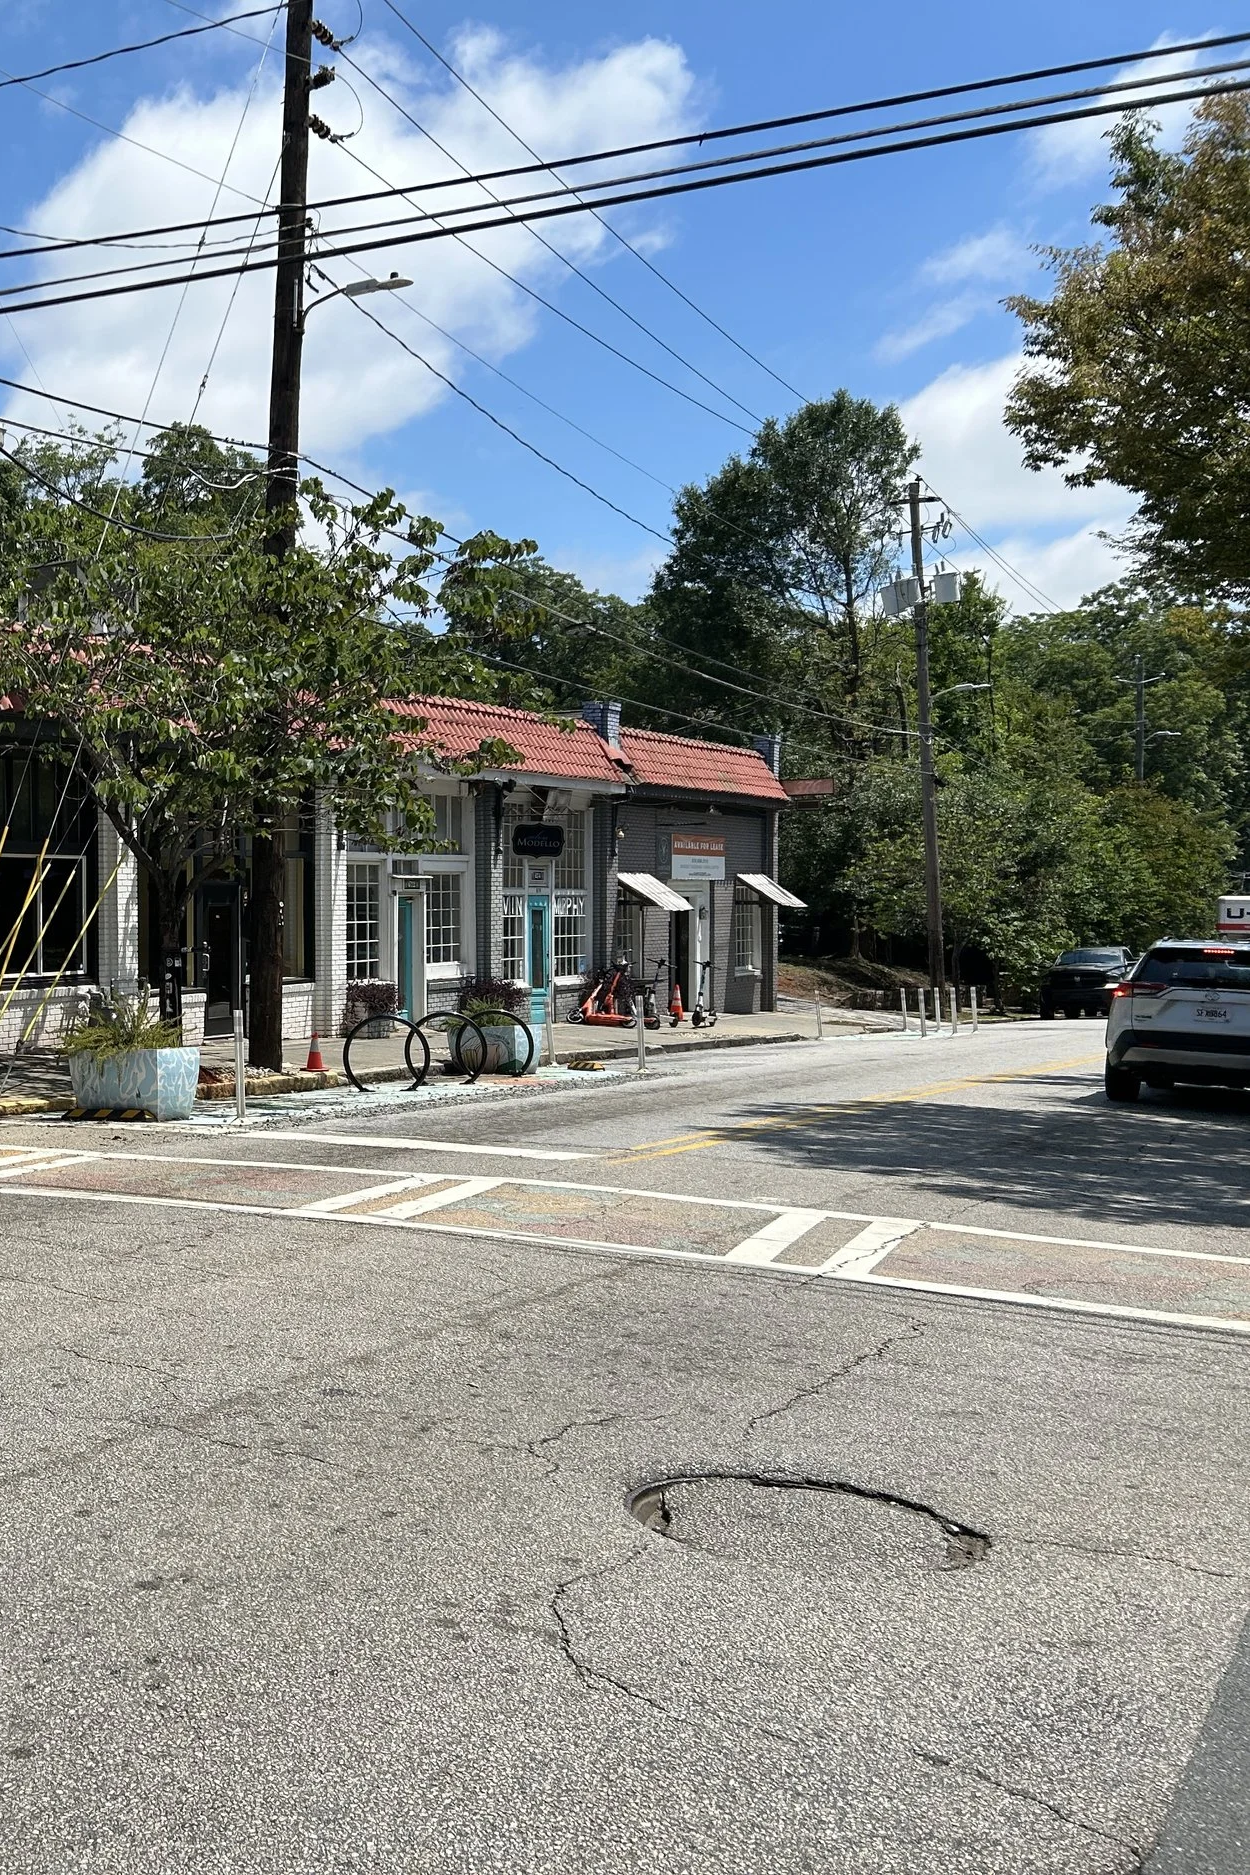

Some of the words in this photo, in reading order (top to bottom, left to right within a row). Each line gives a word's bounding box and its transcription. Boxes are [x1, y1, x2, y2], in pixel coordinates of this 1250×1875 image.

[674, 841, 699, 850] AVAILABLE
[700, 842, 710, 850] FOR
[710, 843, 724, 851] LEASE
